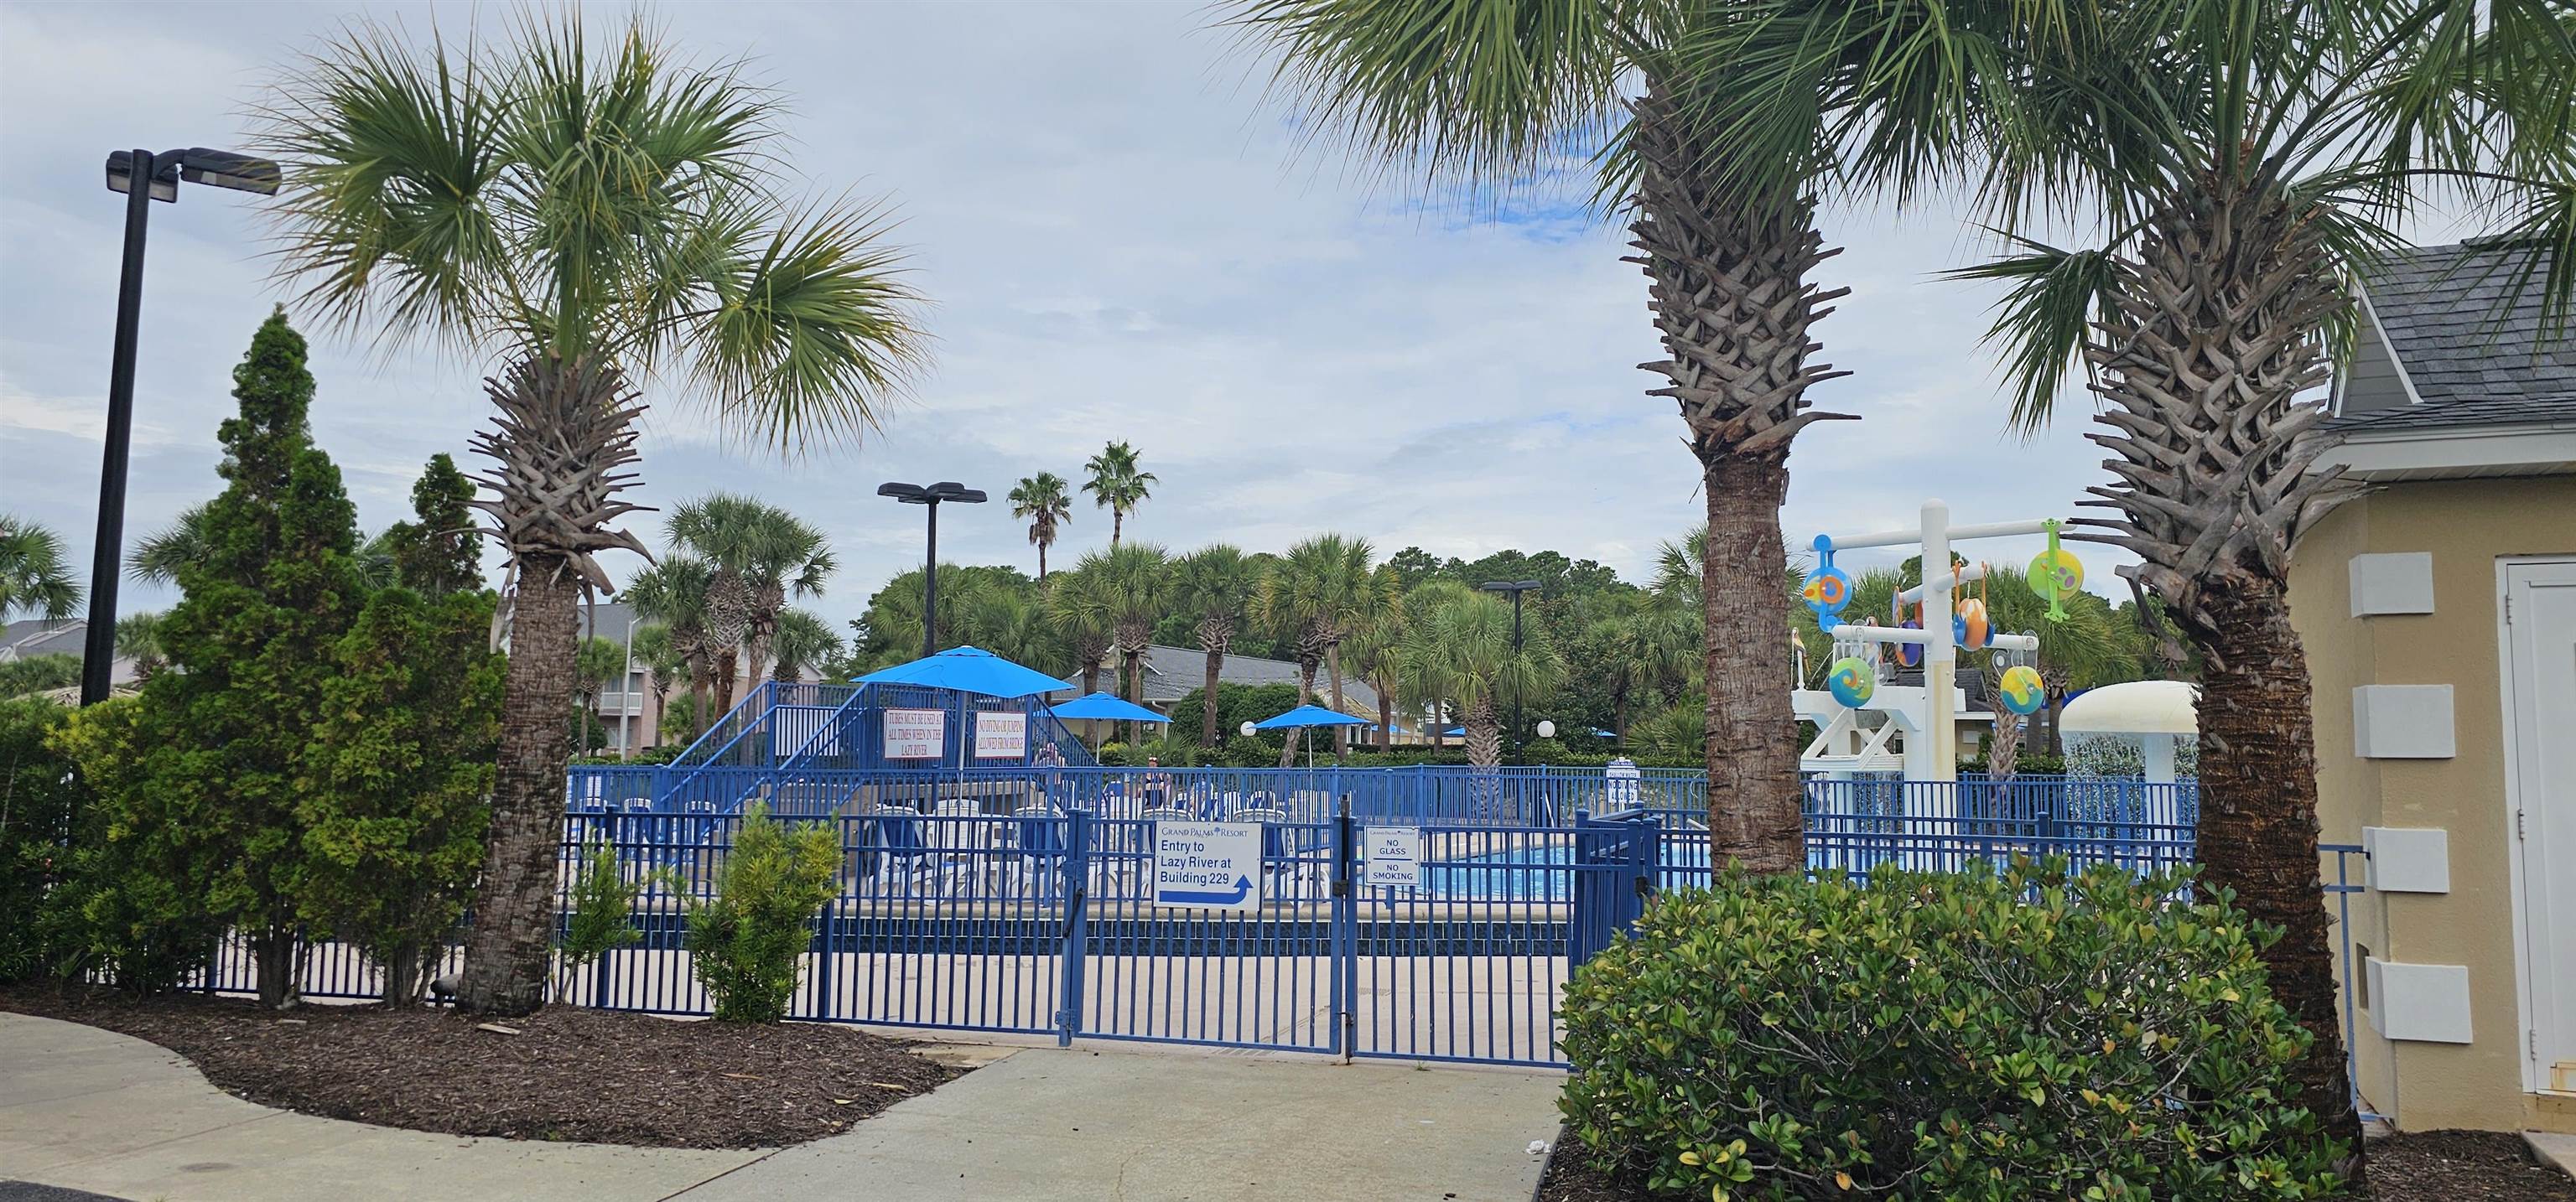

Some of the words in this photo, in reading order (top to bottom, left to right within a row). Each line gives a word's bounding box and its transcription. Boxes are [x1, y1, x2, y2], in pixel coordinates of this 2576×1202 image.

[889, 712, 904, 724] TUBES
[904, 713, 917, 724] MUST
[917, 713, 923, 724] BE
[924, 713, 935, 725] USED
[936, 714, 942, 725] AT
[979, 720, 986, 732] NO
[986, 720, 1001, 732] DIVING
[1001, 720, 1007, 732] OR
[1006, 720, 1023, 734] JUMPING
[888, 729, 897, 740] ALL
[898, 729, 911, 740] TIMES
[912, 729, 926, 740] WHEN
[927, 729, 932, 740] IN
[933, 729, 941, 740] THE
[978, 738, 998, 749] ALLOWED
[998, 738, 1009, 749] FROM
[1010, 738, 1023, 749] BRIDGE
[901, 744, 913, 756] LAZY
[913, 744, 927, 756] RIVER
[1618, 781, 1638, 790] DIVNG
[1610, 792, 1635, 800] AOED
[1161, 827, 1189, 836] GRAND
[1190, 828, 1214, 837] PALMS
[1221, 828, 1248, 837] RESORT
[1162, 840, 1191, 854] Entry
[1193, 841, 1204, 852] to
[1161, 855, 1186, 870] Lazy
[1189, 856, 1218, 868] River
[1220, 858, 1231, 868] at
[1161, 871, 1207, 886] Building
[1210, 873, 1229, 884] 229
